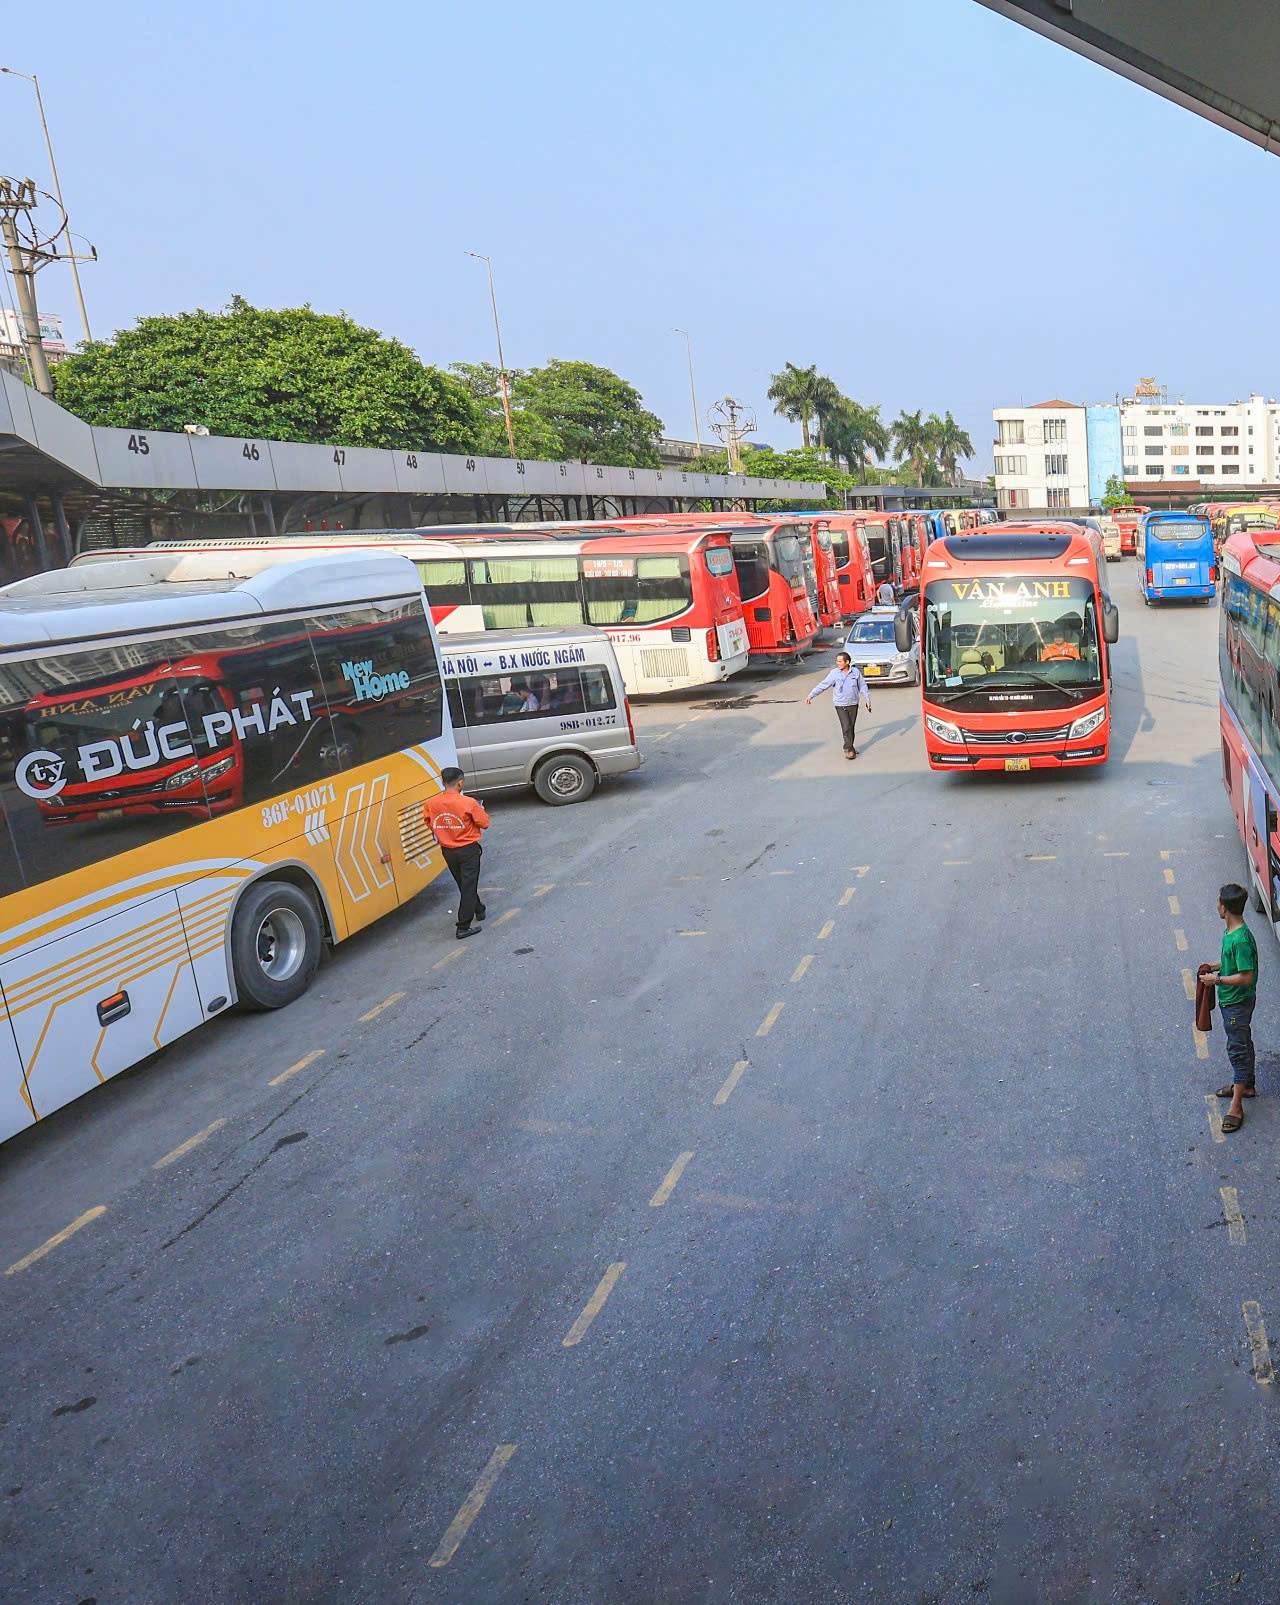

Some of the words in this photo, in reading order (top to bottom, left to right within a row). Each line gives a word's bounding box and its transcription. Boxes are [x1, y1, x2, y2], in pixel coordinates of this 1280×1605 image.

[127, 434, 150, 455] 45
[242, 443, 260, 461] 46
[333, 449, 346, 466] 47
[406, 455, 418, 469] 48
[465, 459, 476, 472] 49
[516, 462, 526, 475] 50
[559, 465, 567, 477] 51
[596, 468, 604, 479] 52
[628, 470, 636, 480] 53
[951, 578, 1005, 600] VÂN
[1015, 581, 1071, 599] ANH
[457, 655, 478, 676] NỘI
[499, 652, 519, 670] B.X
[521, 647, 551, 668] NƯỚC
[554, 645, 586, 665] NGẦM
[341, 660, 374, 681] New
[352, 670, 411, 702] Home
[559, 721, 580, 731] 98B
[585, 714, 616, 727] 012.77
[77, 717, 195, 783] ĐỨC
[202, 686, 315, 749] PHÁT
[261, 783, 338, 829] 36F-01071
